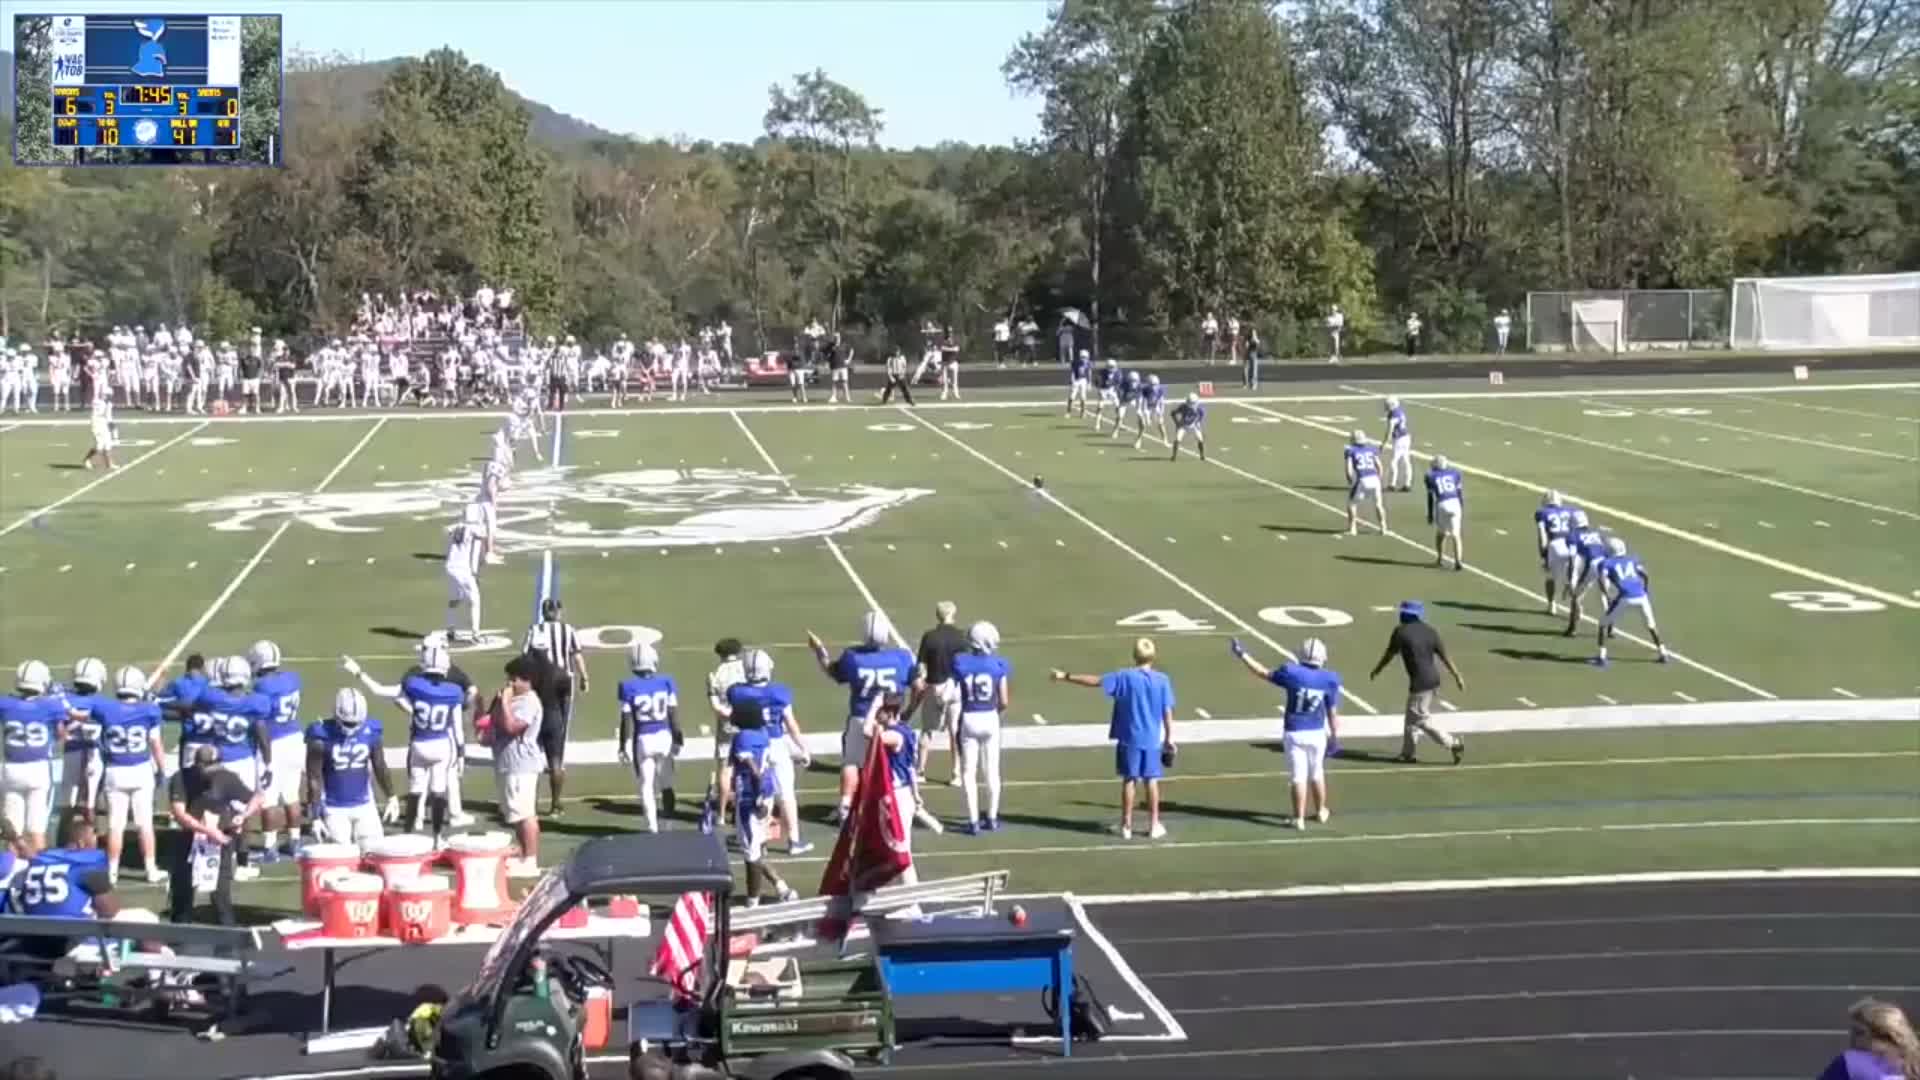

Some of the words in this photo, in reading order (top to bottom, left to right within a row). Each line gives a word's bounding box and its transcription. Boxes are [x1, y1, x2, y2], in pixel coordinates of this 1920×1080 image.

[1355, 452, 1375, 470] 35
[1435, 475, 1455, 494] 16
[1615, 561, 1637, 581] 14
[858, 667, 897, 698] 75
[965, 673, 994, 701] 13
[635, 691, 669, 722] 20
[1296, 688, 1324, 713] 17
[415, 702, 449, 731] 30
[4, 720, 49, 747] 29
[332, 744, 368, 770] 52
[24, 865, 70, 904] 55
[732, 1019, 799, 1034] Kawasaki
